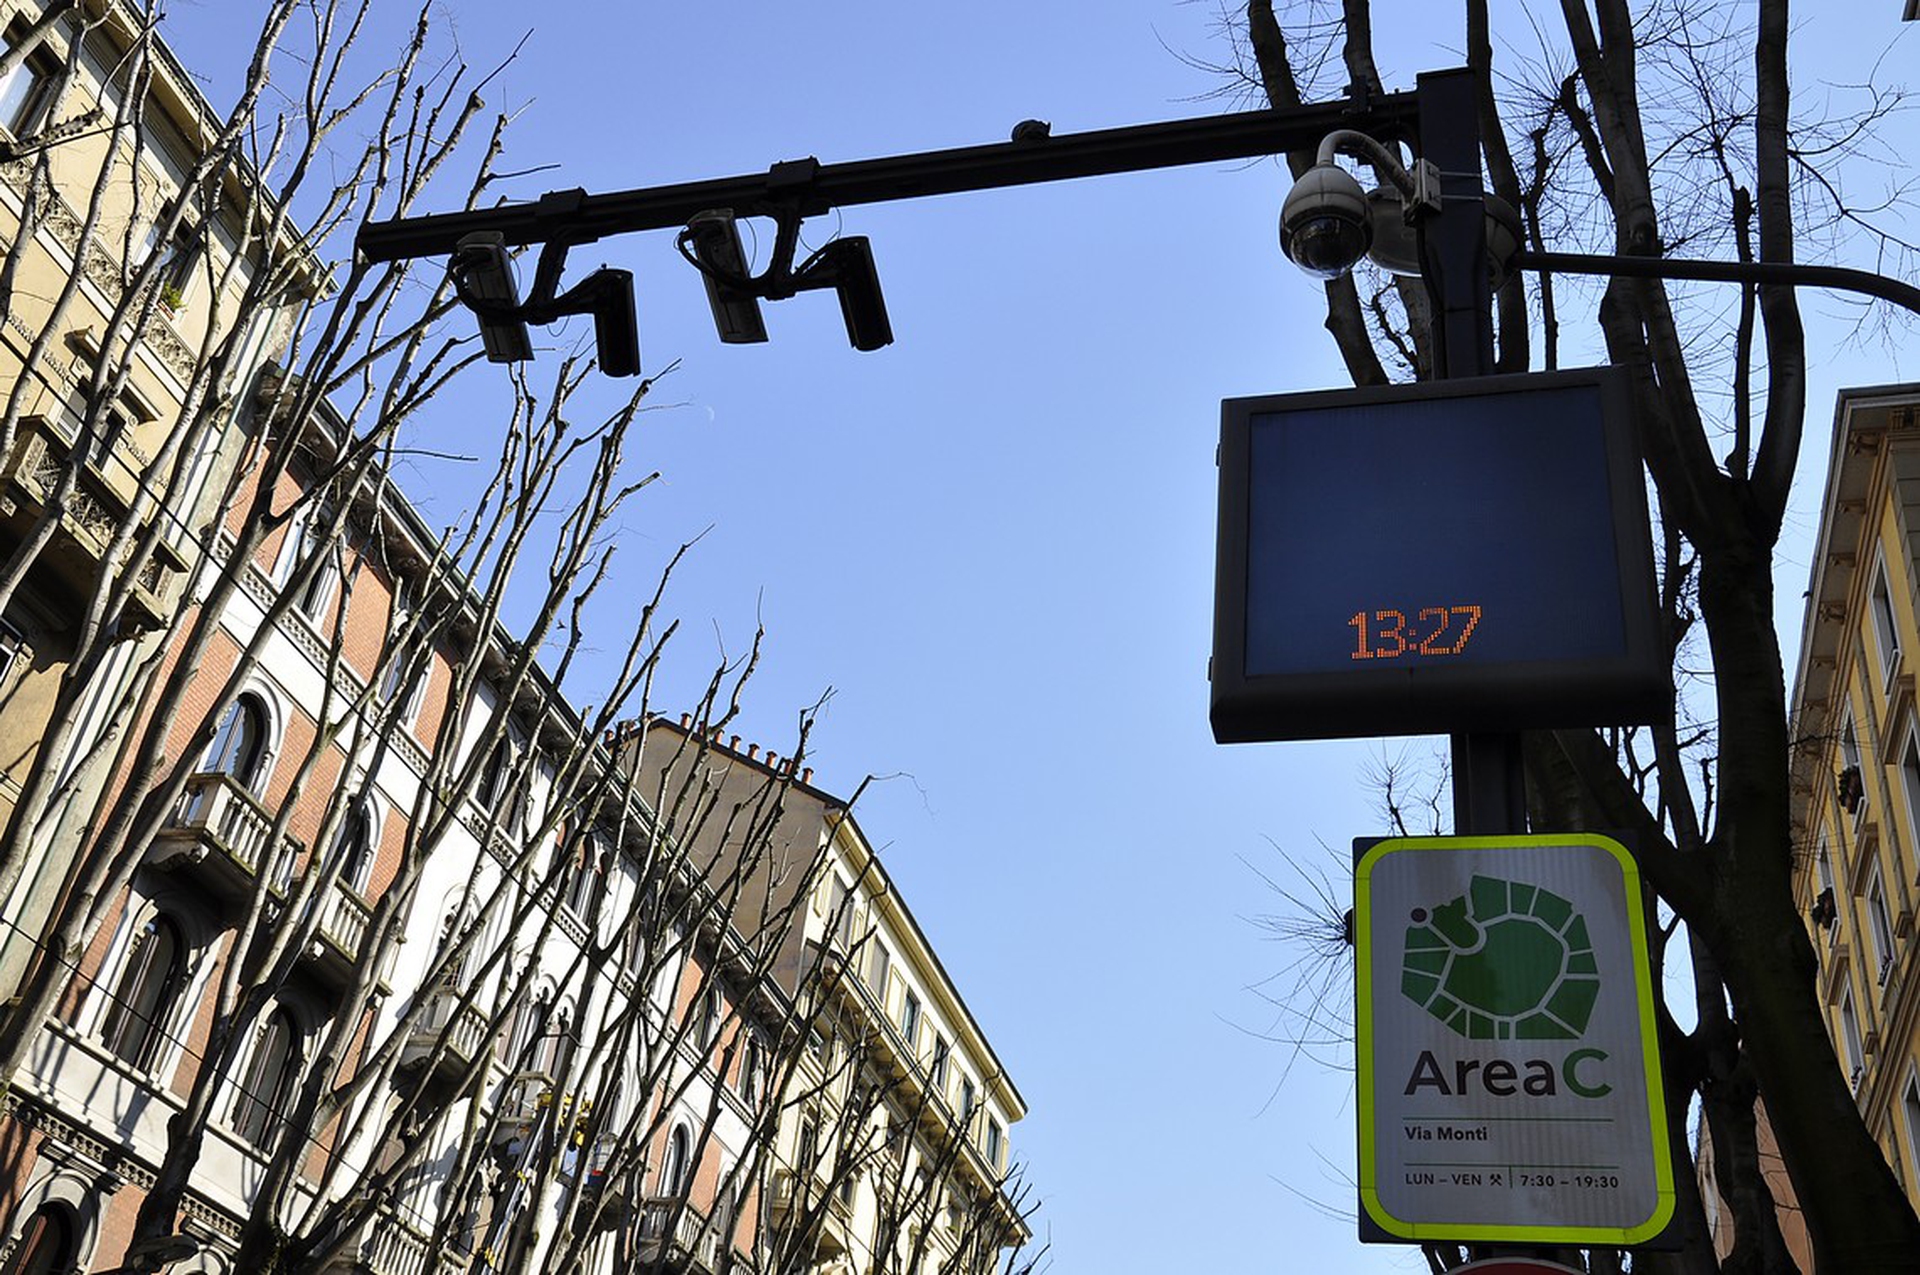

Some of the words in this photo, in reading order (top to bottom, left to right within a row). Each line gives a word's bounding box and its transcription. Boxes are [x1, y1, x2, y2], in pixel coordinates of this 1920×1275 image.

[1348, 605, 1482, 659] 13:27
[1404, 1126, 1432, 1141] Via
[1437, 1126, 1488, 1141] Monti
[1405, 1173, 1434, 1185] LUN
[1451, 1174, 1482, 1186] VEN
[1520, 1174, 1555, 1187] 7:30
[1575, 1175, 1619, 1188] 19:30
